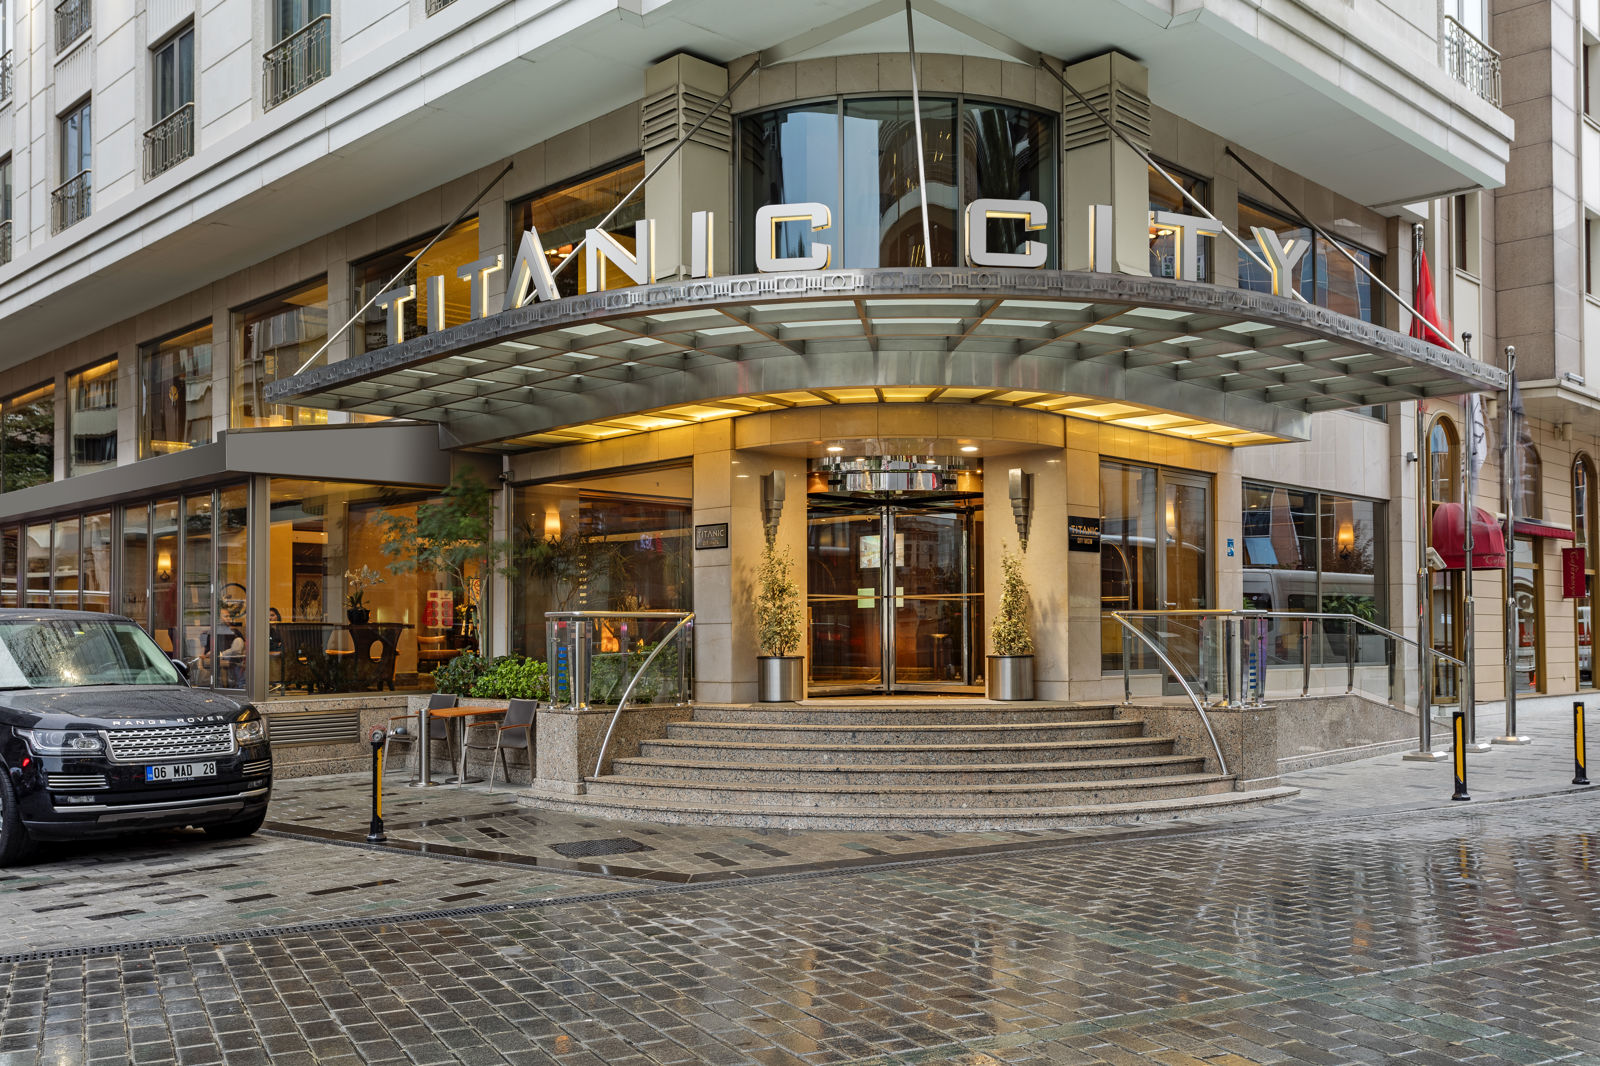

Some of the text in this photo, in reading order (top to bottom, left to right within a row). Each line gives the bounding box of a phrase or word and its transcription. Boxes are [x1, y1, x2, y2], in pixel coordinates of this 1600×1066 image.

[376, 198, 1311, 344] TITANIC CITY
[698, 529, 724, 539] TITANIC
[1071, 525, 1099, 536] TITANIC
[112, 715, 225, 727] RANGE ROVER
[153, 762, 215, 779] 06 MAD 28
